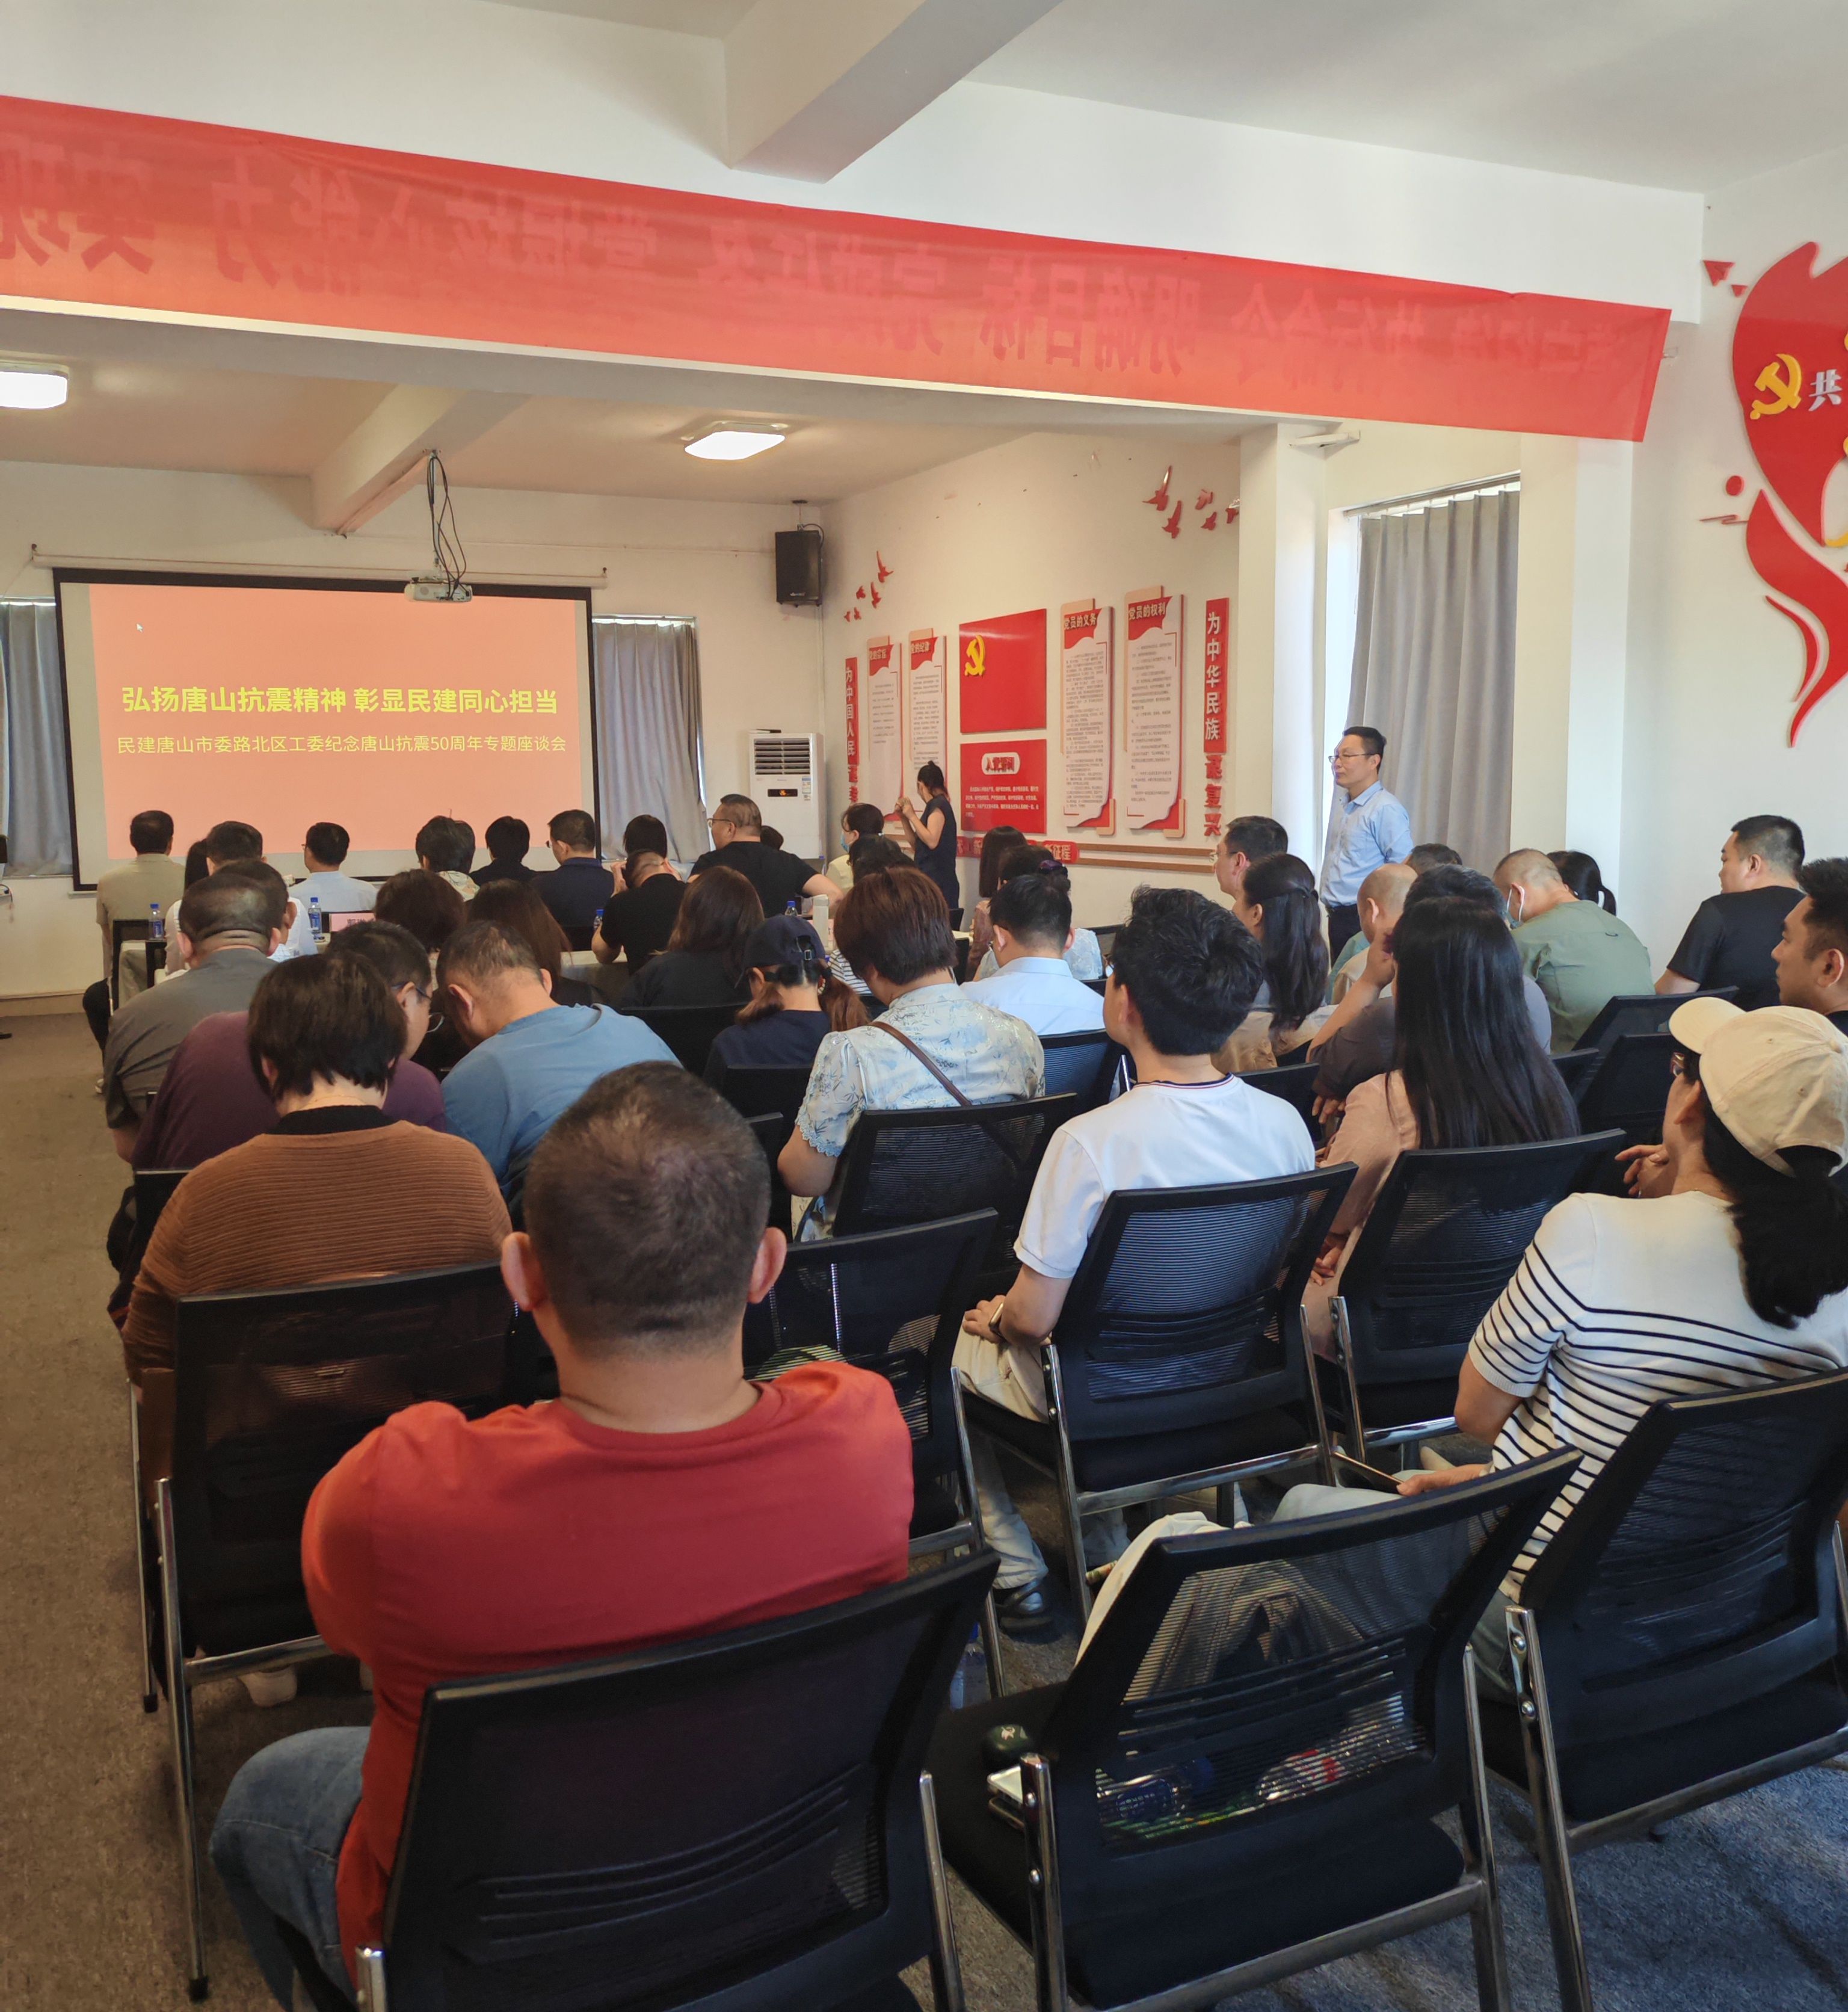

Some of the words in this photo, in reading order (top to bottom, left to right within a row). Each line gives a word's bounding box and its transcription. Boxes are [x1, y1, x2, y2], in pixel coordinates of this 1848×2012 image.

[1808, 368, 1842, 412] 共
[1064, 613, 1097, 630] 党员的义务
[1129, 603, 1165, 620] 党员的权利
[1205, 613, 1222, 741] 为中华民族
[122, 686, 346, 713] 弘扬唐山抗震精神
[353, 687, 557, 714] 彰显民建同心担当
[117, 735, 566, 754] 民建唐山市委路北区工委纪念唐山抗震50周年专题座谈会
